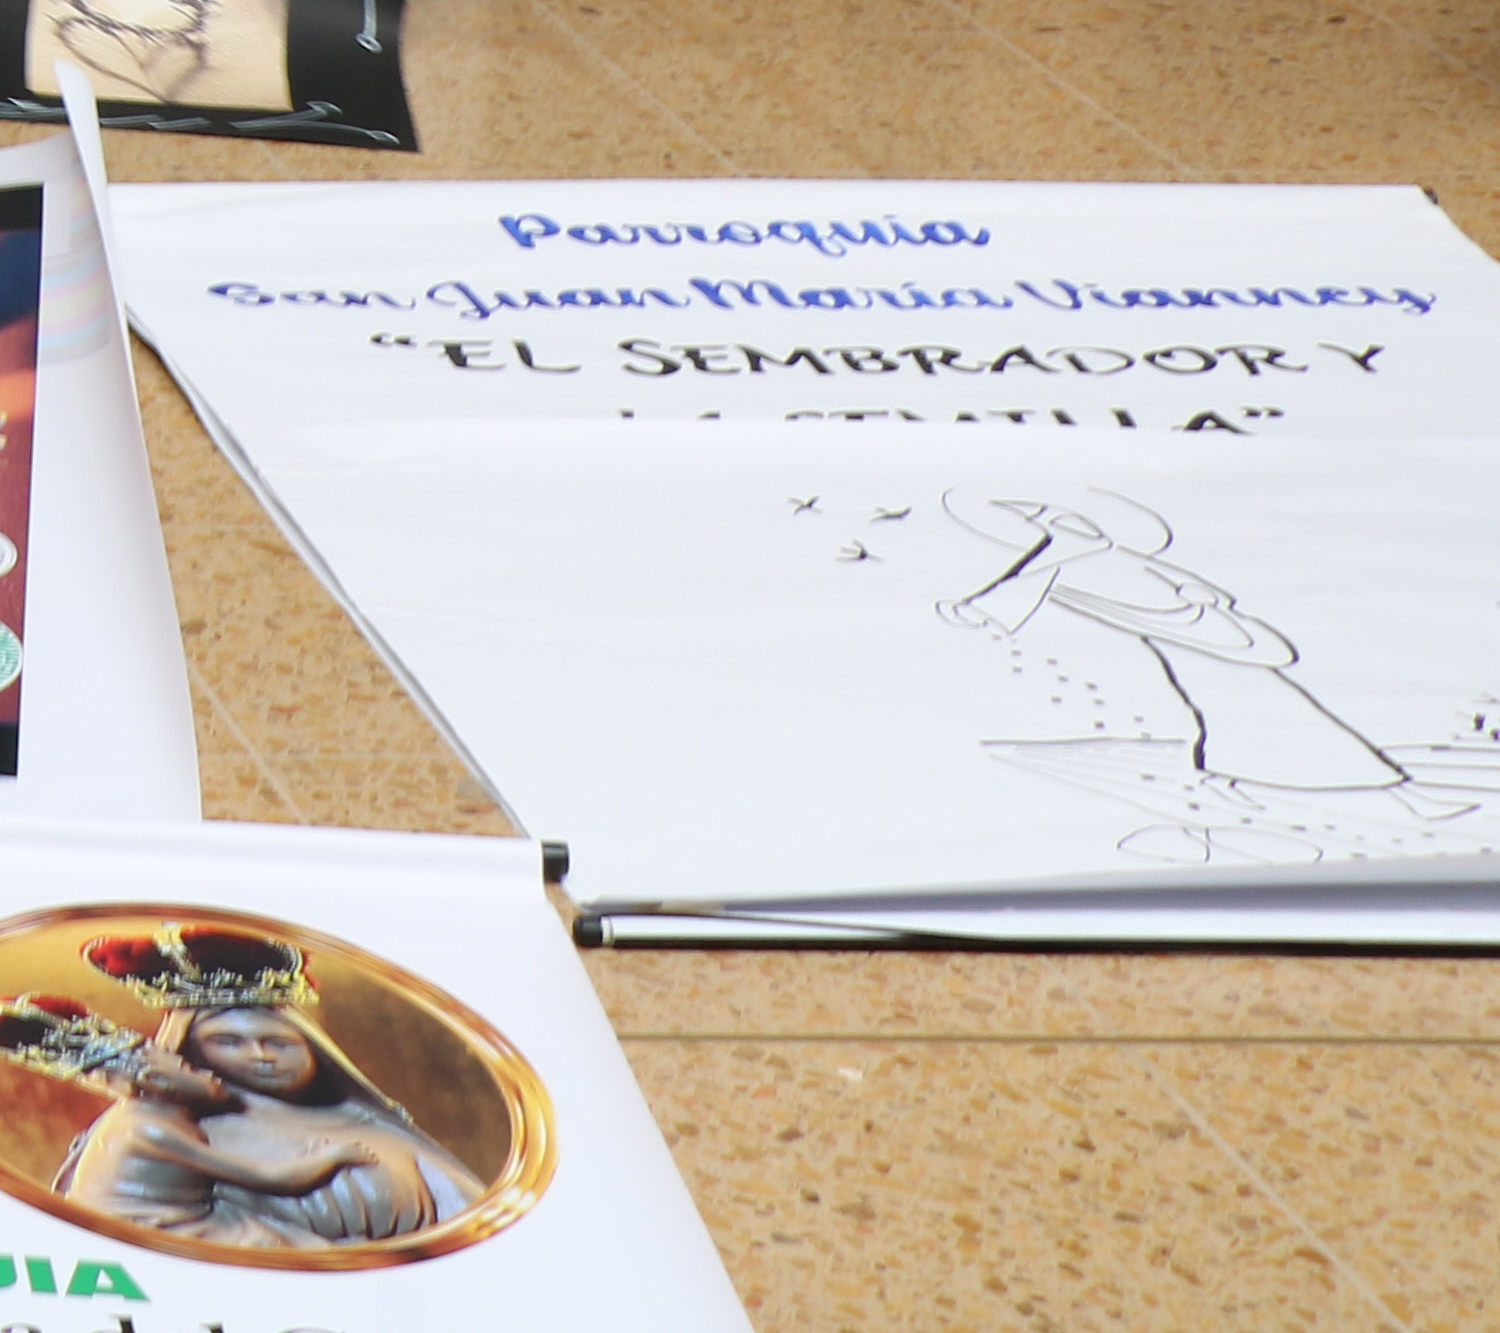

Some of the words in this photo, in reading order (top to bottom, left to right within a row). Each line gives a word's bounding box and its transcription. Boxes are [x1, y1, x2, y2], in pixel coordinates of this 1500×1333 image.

[495, 211, 991, 259] Parroquia
[208, 279, 417, 314] San
[424, 278, 693, 320] Juan
[1013, 276, 1440, 317] Vianney
[617, 337, 1310, 379] SEMBRADOR
[1314, 341, 1388, 376] Y
